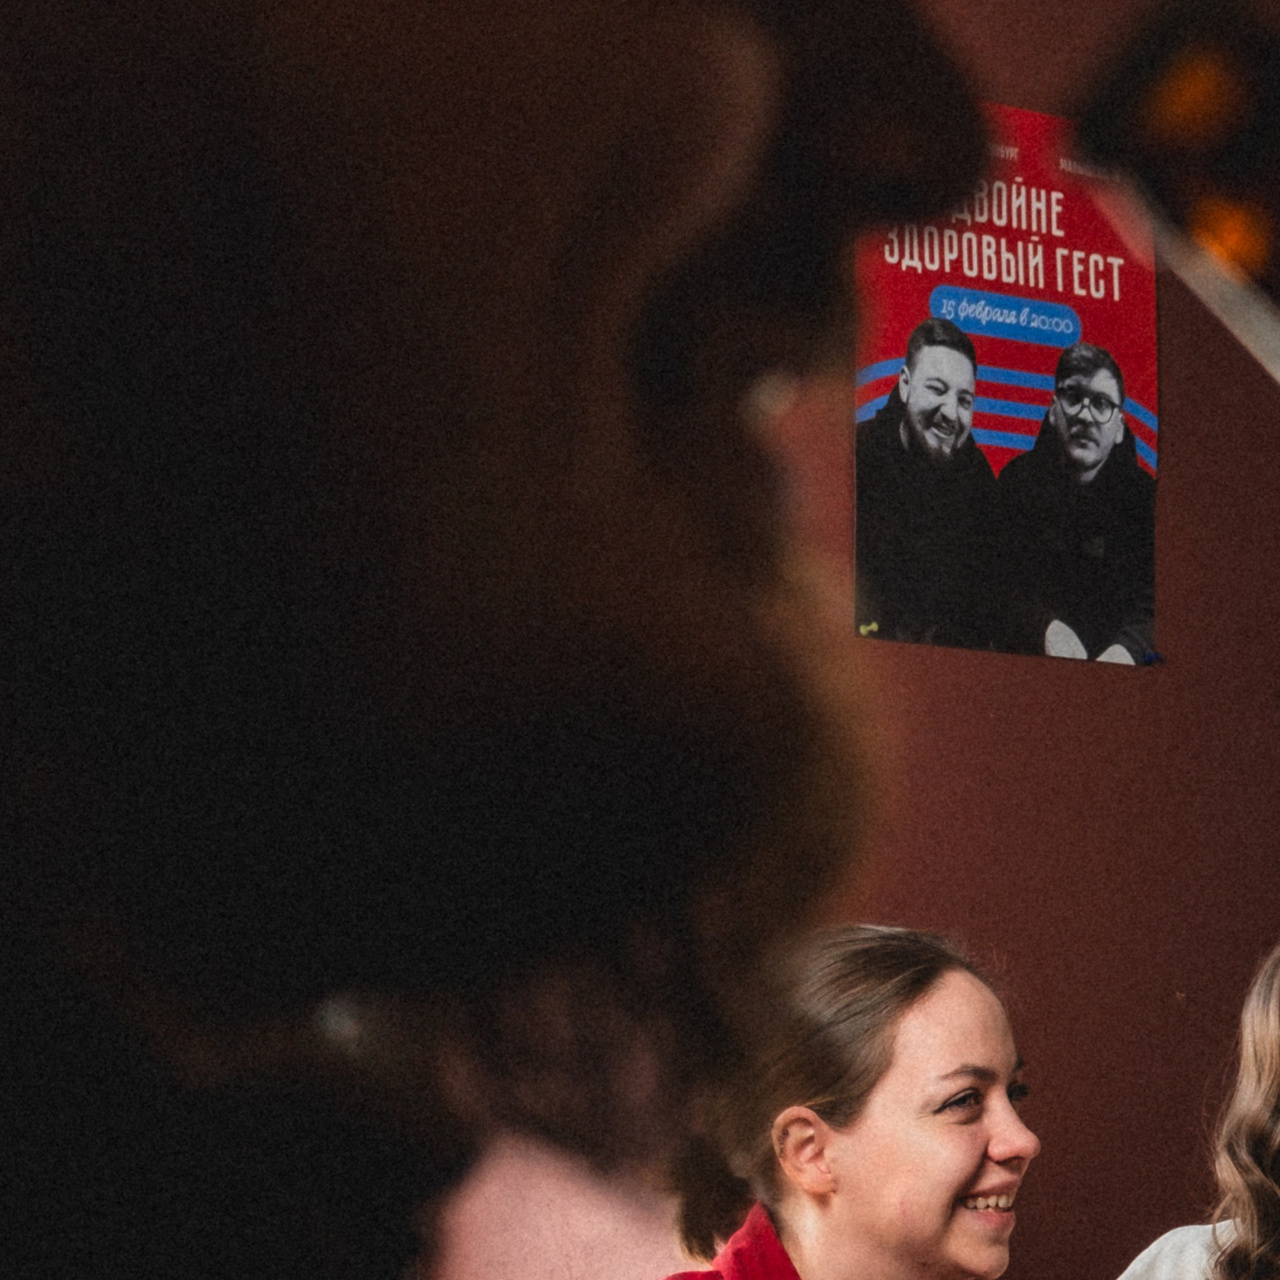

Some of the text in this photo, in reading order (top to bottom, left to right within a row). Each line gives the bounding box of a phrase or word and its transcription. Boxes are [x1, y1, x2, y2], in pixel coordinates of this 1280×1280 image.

[884, 225, 1125, 302] ЗДОРОВЫЙ ГЕСТ
[941, 299, 956, 320] 15
[957, 297, 1018, 325] февраля
[1030, 312, 1074, 334] 20:00
